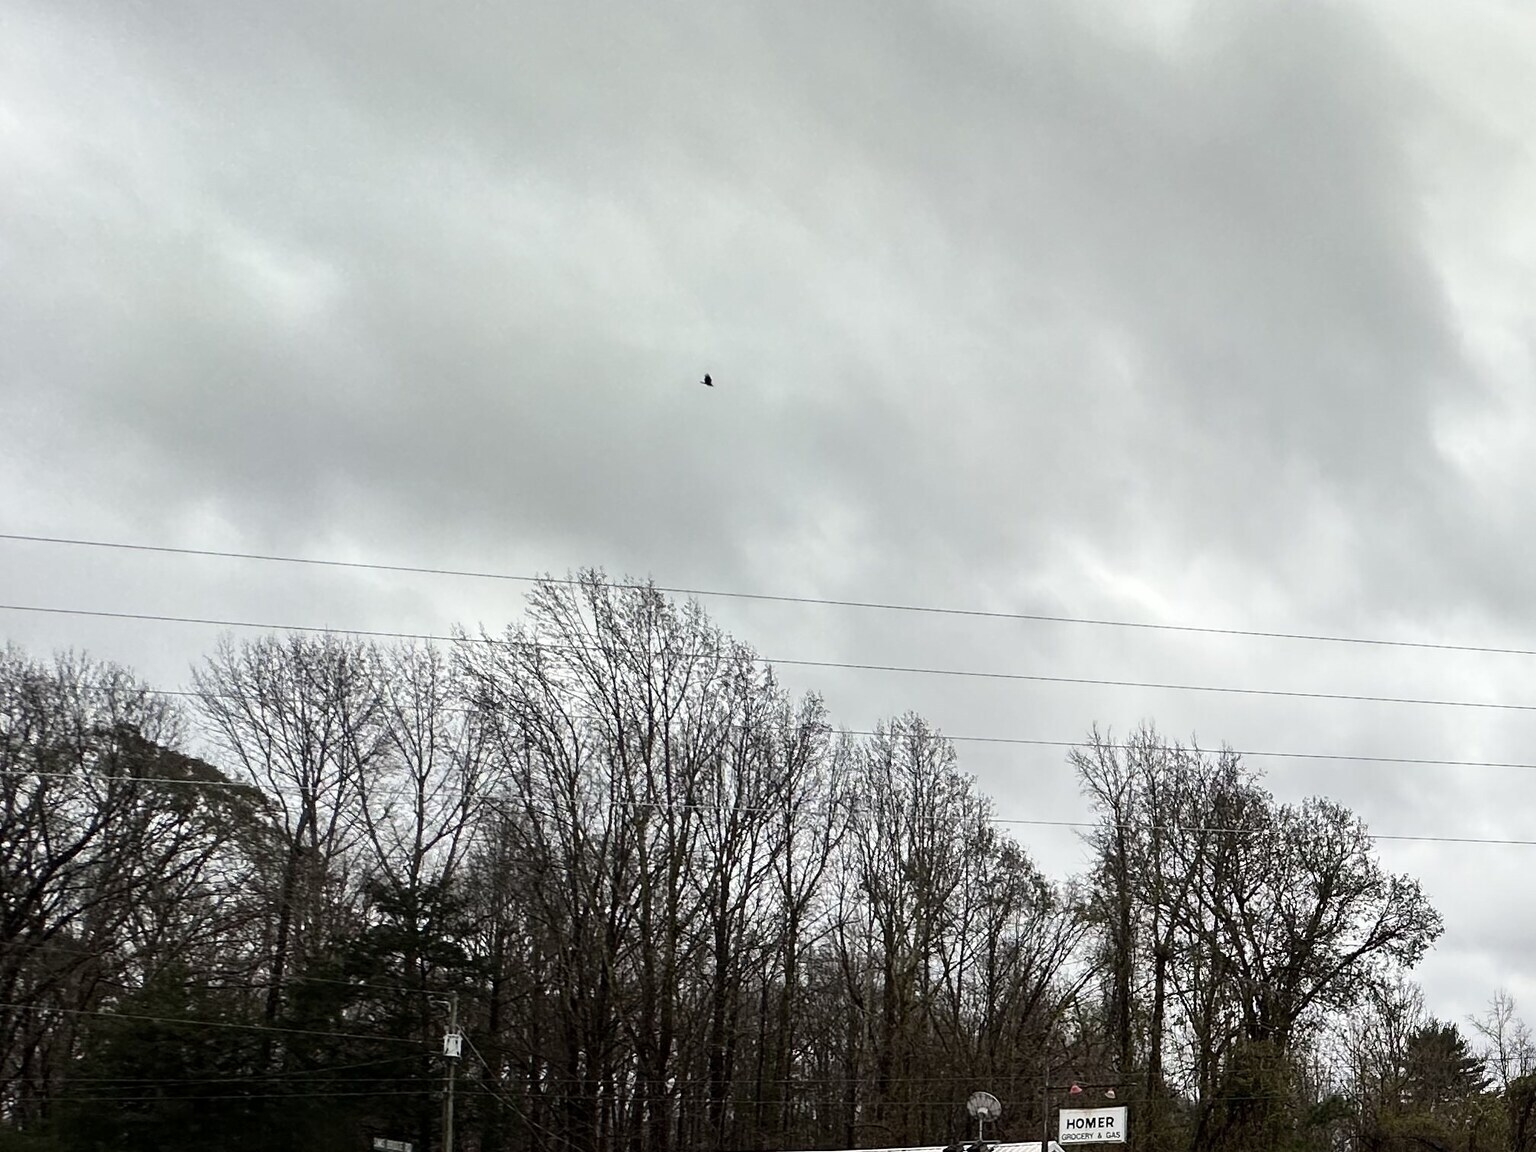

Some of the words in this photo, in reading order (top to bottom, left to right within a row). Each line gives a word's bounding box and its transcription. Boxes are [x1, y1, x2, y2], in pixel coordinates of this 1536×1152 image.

[1066, 1117, 1115, 1129] HOMER
[1061, 1132, 1094, 1141] GROCERY
[1105, 1131, 1121, 1139] GAS
